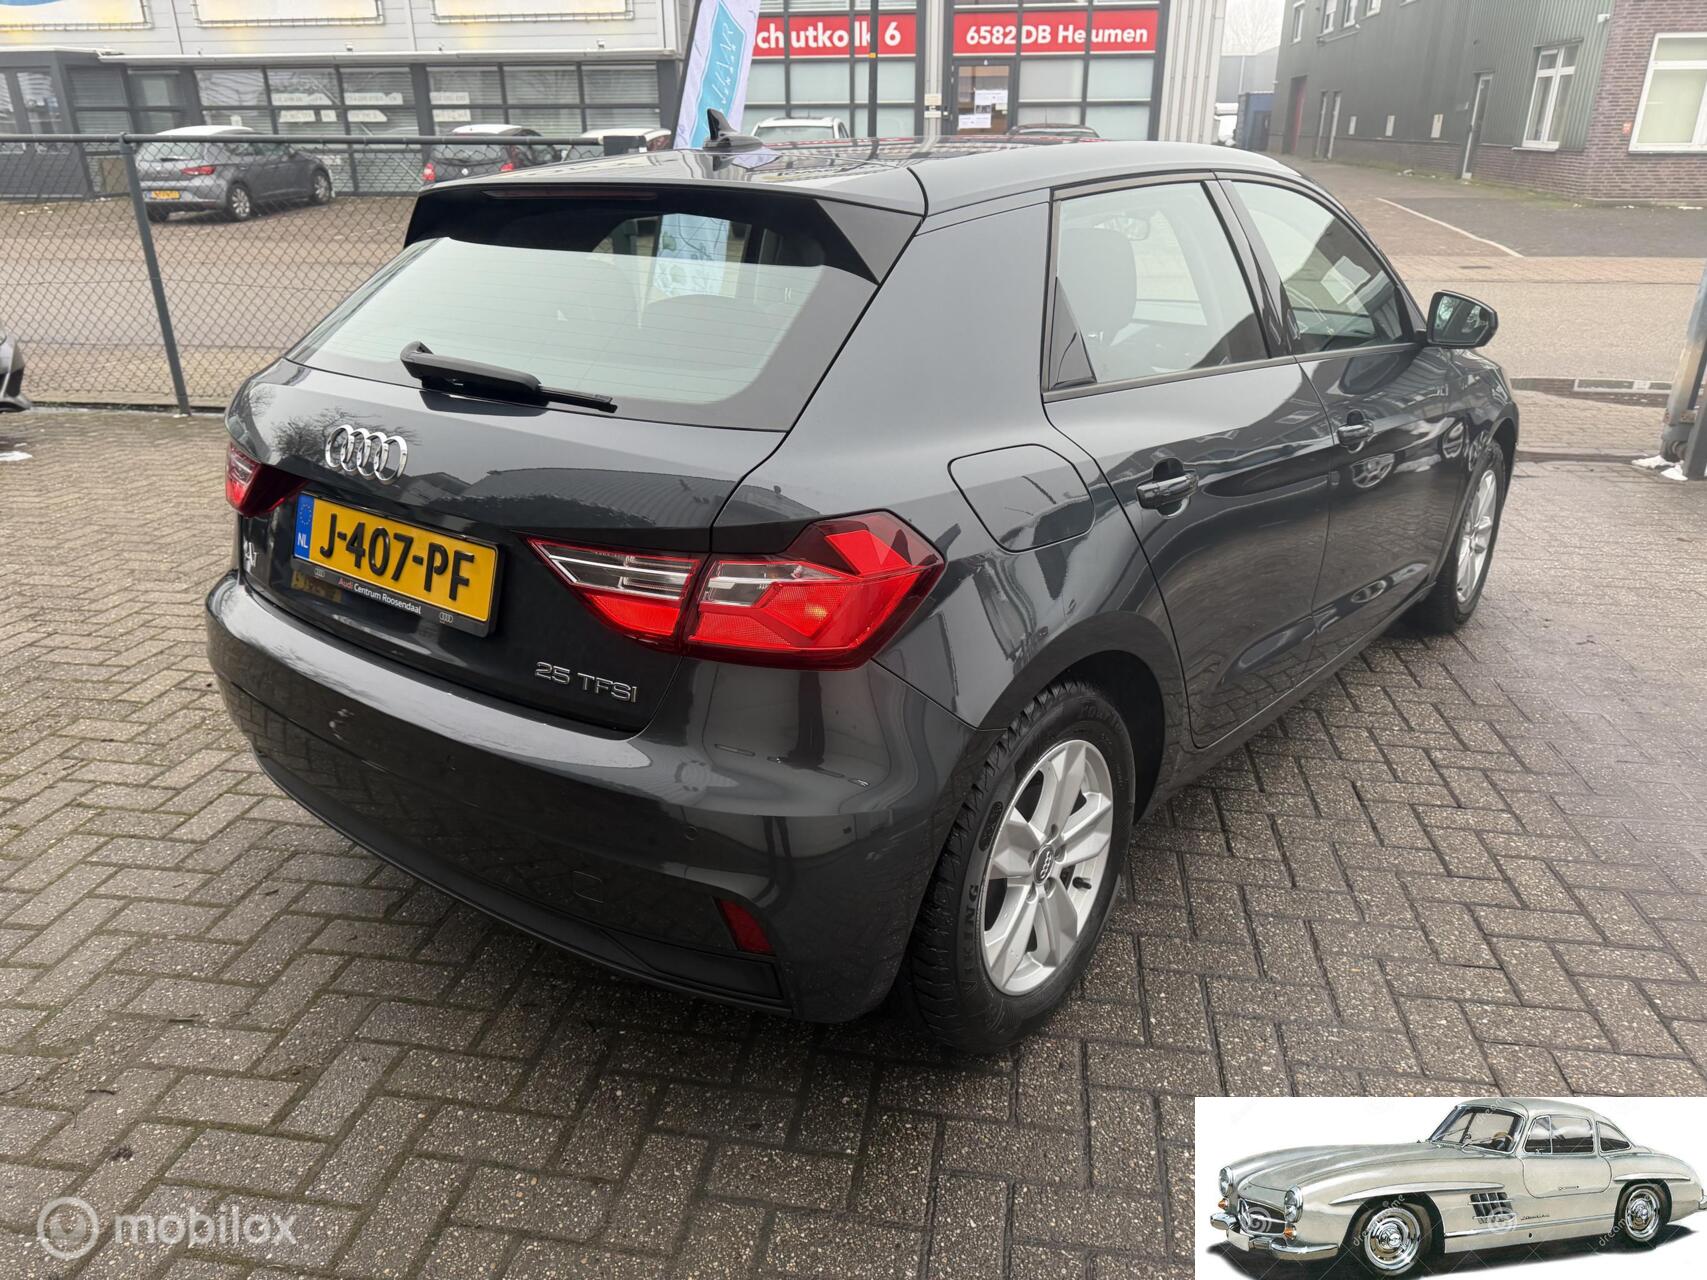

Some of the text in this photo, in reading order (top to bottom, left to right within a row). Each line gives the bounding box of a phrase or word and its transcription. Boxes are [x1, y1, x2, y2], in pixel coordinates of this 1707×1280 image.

[884, 21, 901, 46] 6
[966, 25, 1016, 45] 6582
[1021, 25, 1051, 44] DB
[297, 532, 309, 549] NL
[319, 512, 476, 601] J-407-PF
[338, 577, 422, 615] Audi Centrum Roosendaal
[534, 661, 637, 703] 25 TFSI
